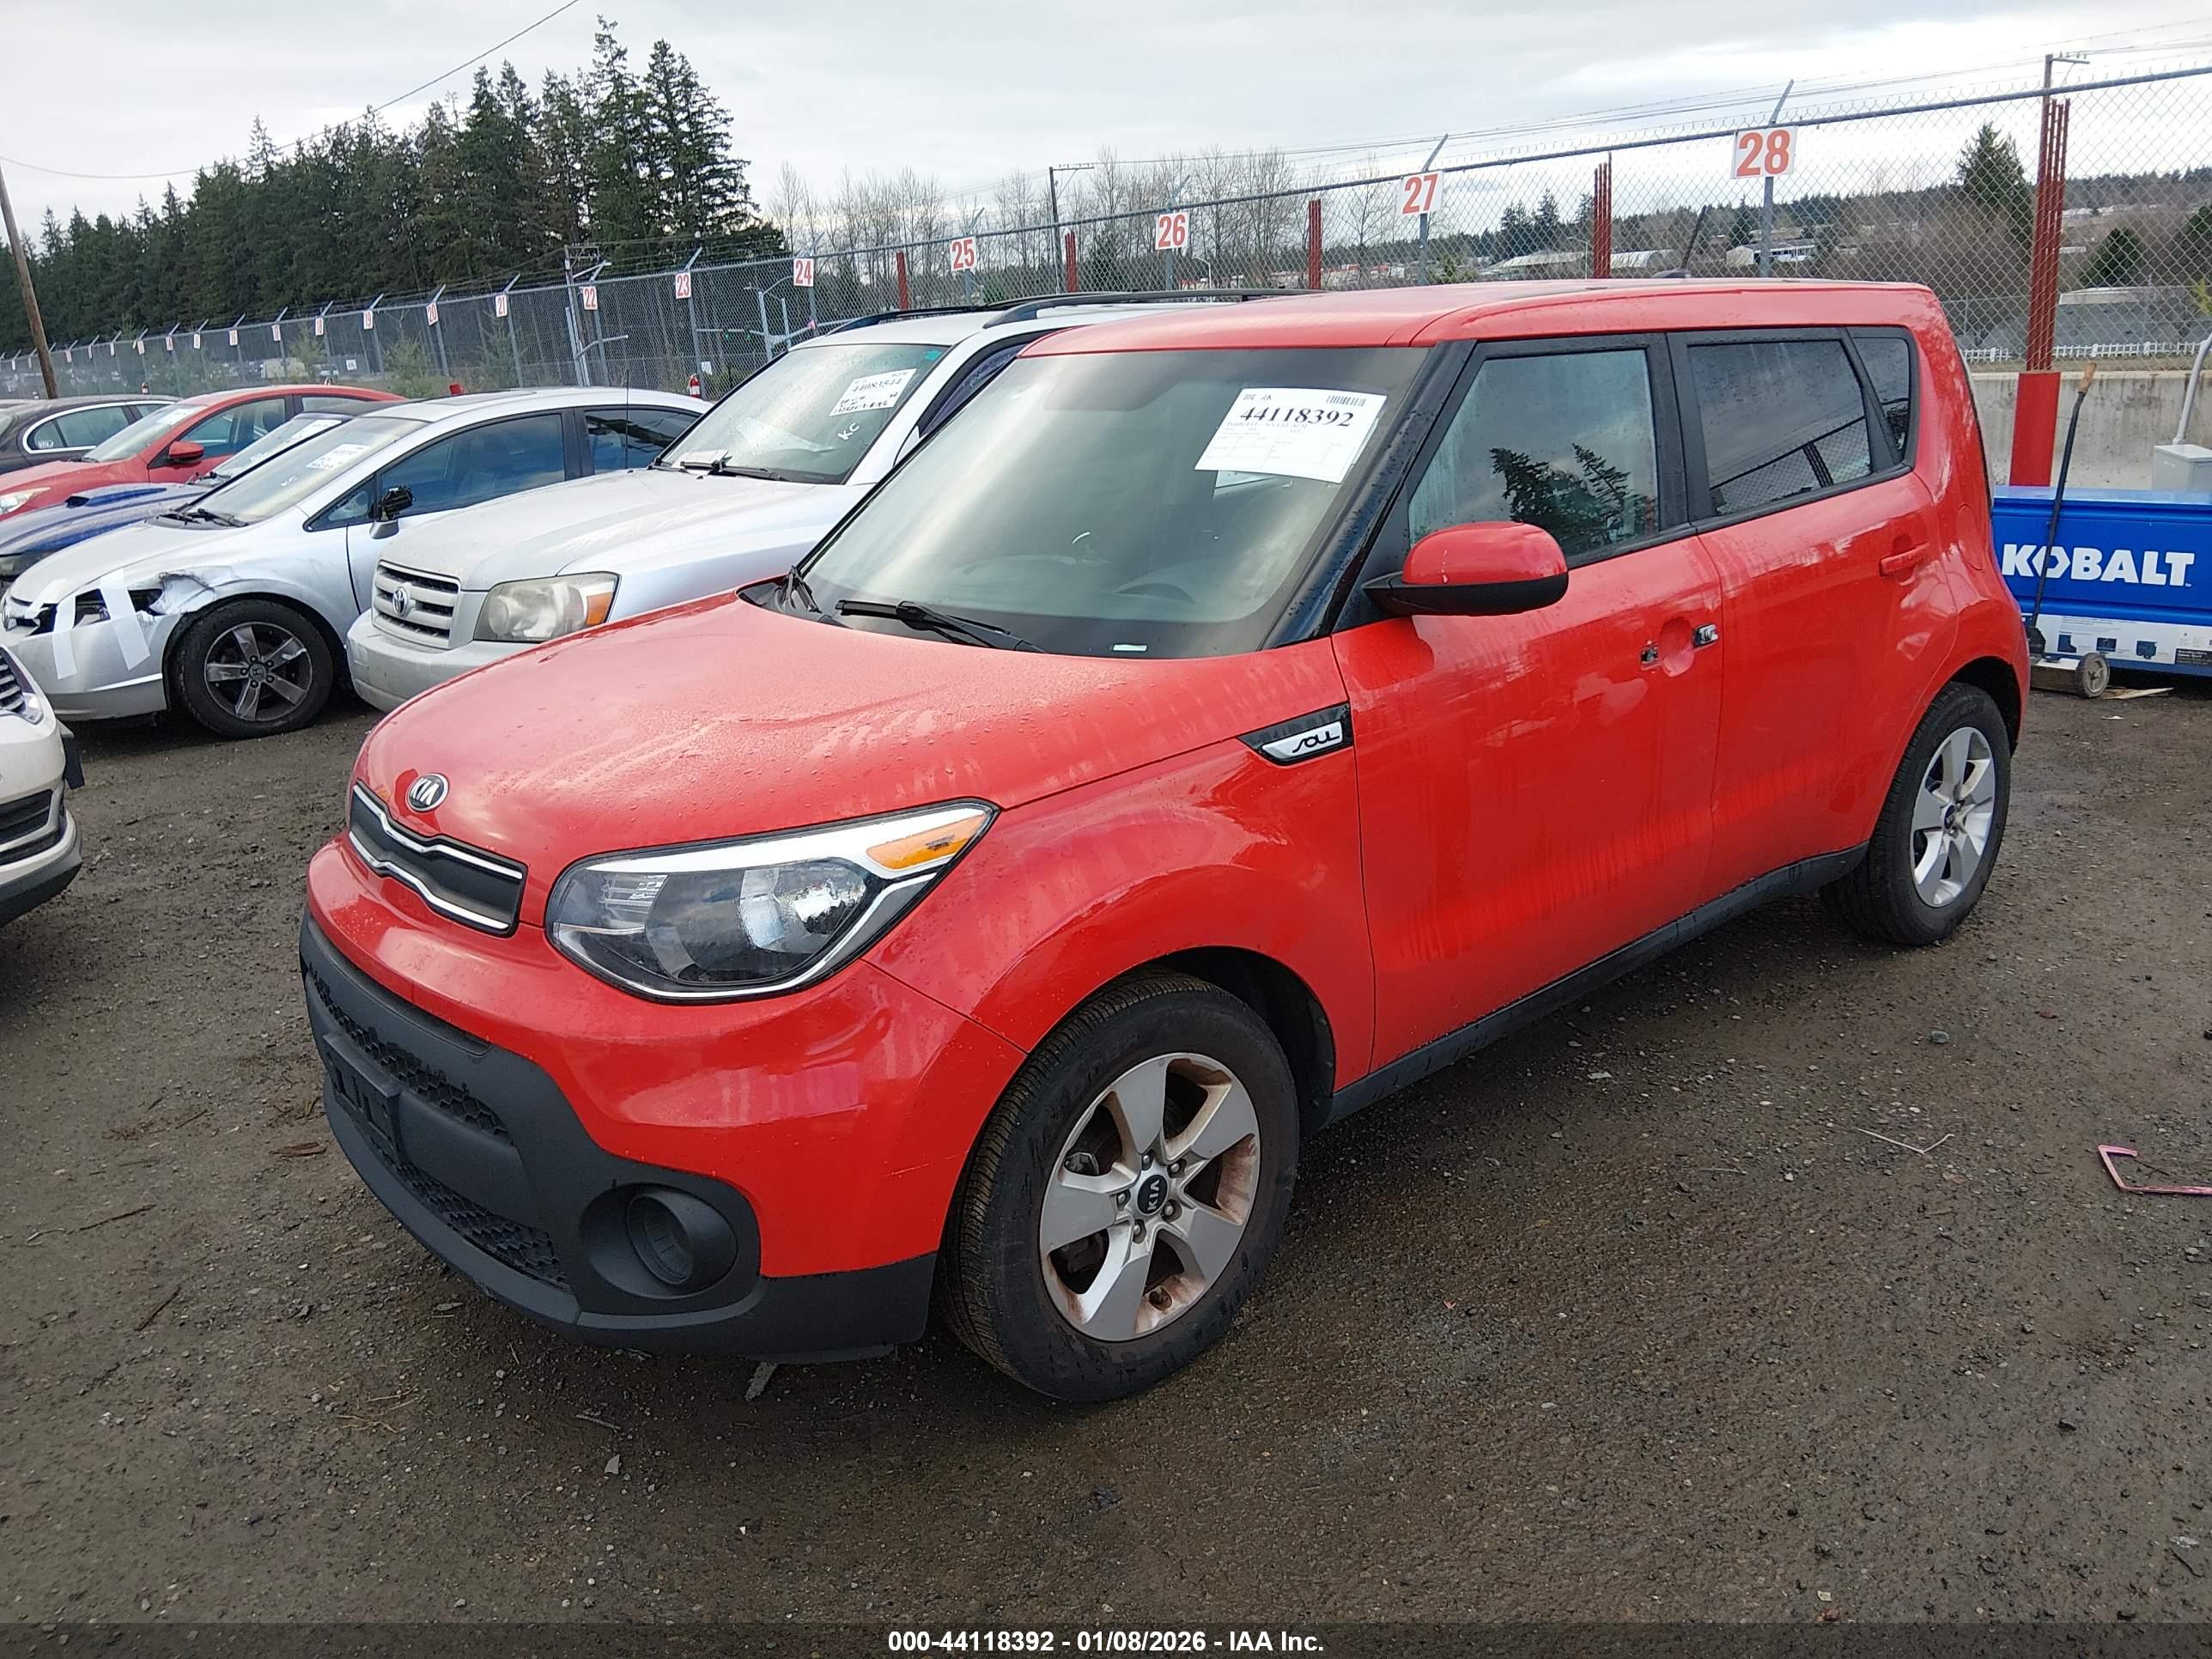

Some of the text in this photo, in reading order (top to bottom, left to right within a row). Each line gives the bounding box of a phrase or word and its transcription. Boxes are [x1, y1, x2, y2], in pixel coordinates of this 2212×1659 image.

[1735, 129, 1791, 177] 28
[1401, 173, 1439, 215] 27
[1158, 214, 1187, 247] 26
[951, 239, 975, 270] 25
[677, 273, 690, 296] 23
[794, 259, 812, 285] 24
[497, 295, 507, 316] 21
[584, 287, 597, 308] 22
[364, 311, 372, 329] 19
[428, 303, 438, 324] 20
[1240, 406, 1354, 428] 44118392
[2002, 544, 2195, 586] KOBALT
[1291, 730, 1340, 754] SOUL
[1146, 1178, 1160, 1212] KIA
